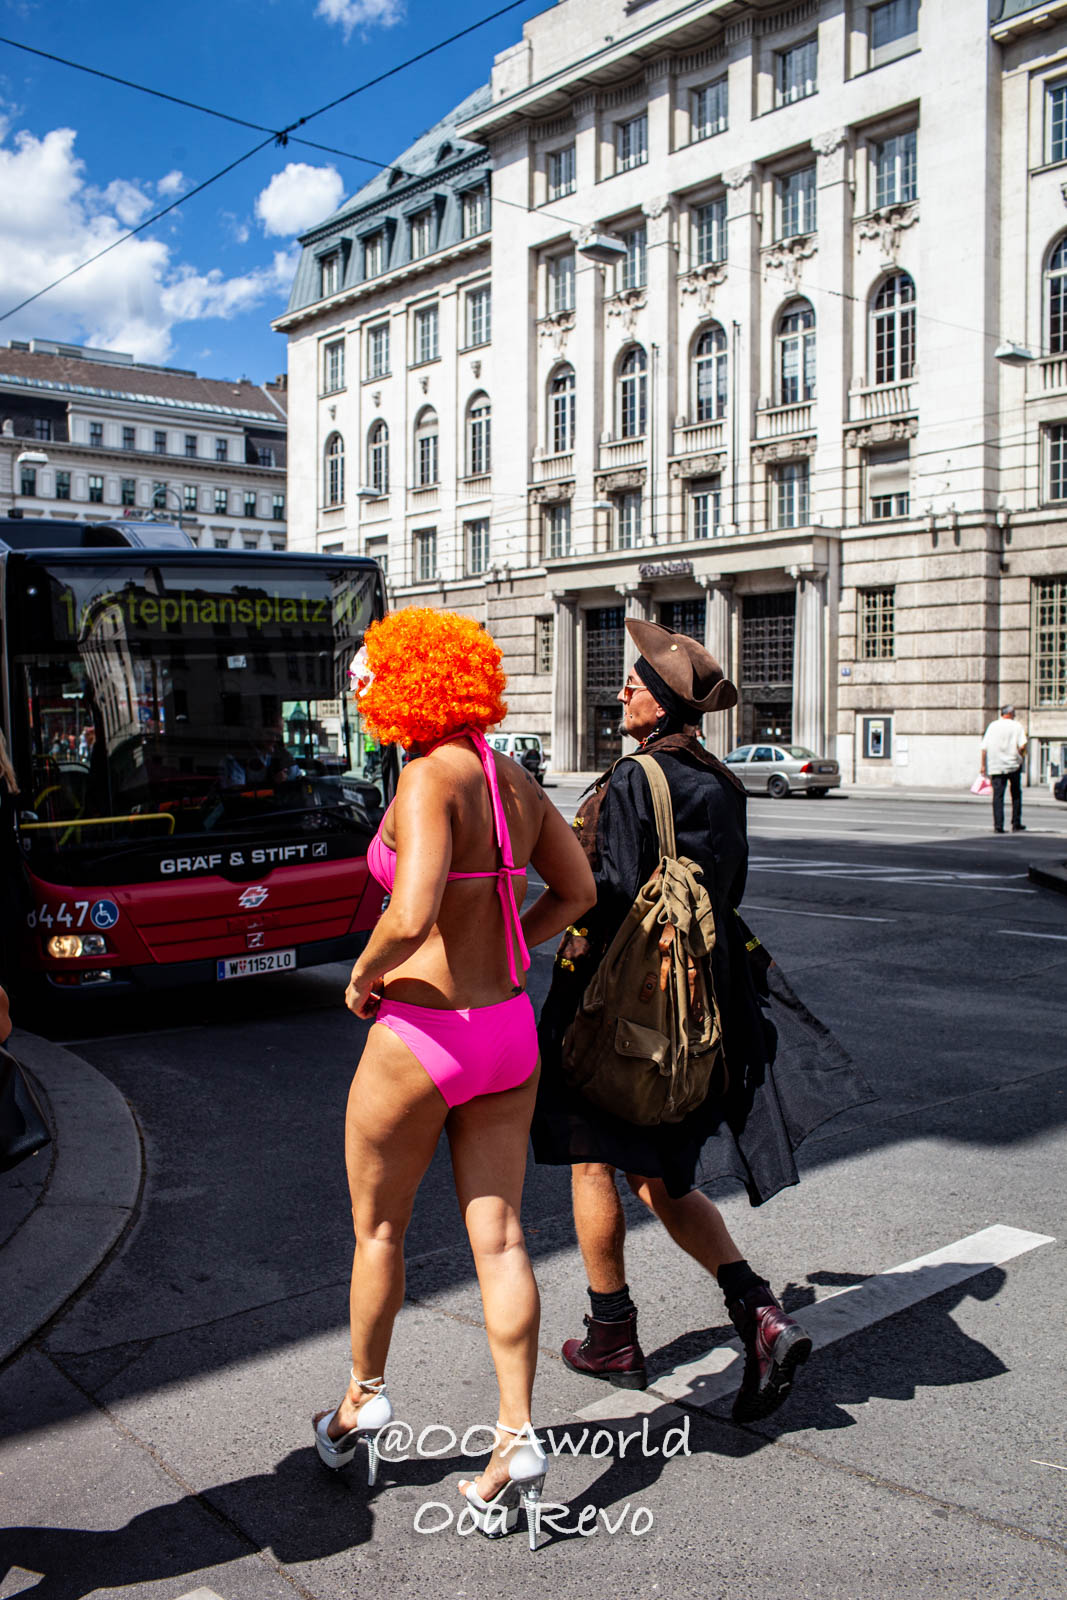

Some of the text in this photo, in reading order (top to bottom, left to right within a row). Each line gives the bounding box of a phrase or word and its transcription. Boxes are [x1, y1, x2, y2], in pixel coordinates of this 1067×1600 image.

[100, 590, 327, 631] Stephansplatz
[160, 845, 309, 874] GRÄF & STIFT
[229, 961, 239, 975] W
[248, 956, 274, 972] 1152
